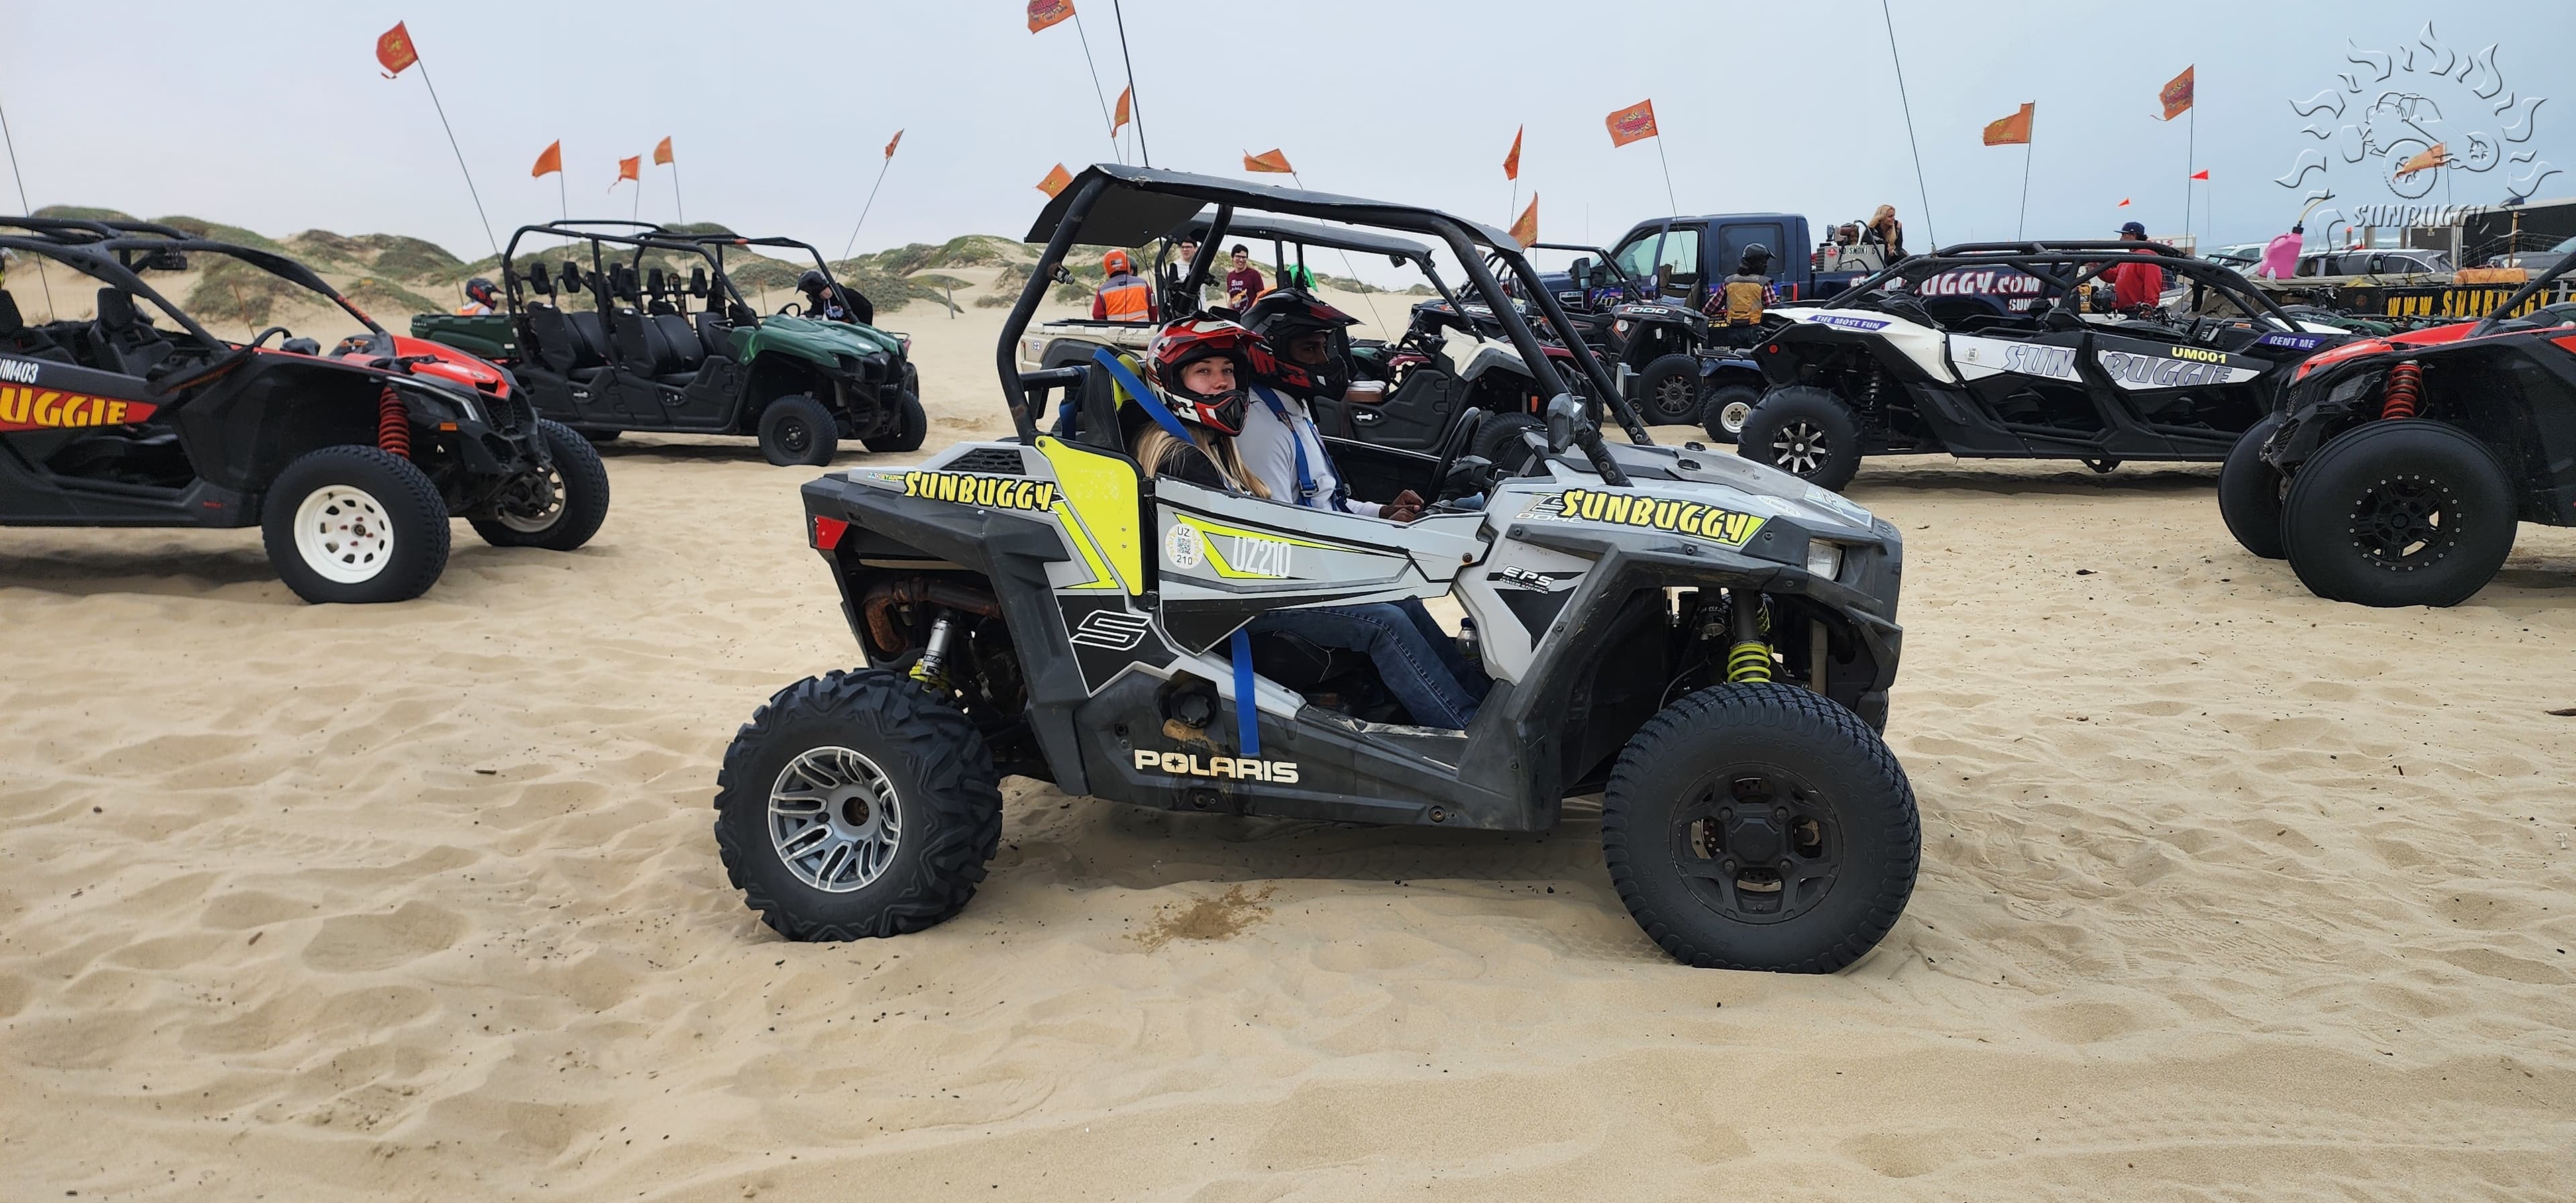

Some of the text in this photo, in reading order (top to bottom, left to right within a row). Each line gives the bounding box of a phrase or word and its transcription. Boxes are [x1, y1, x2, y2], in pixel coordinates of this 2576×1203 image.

[1849, 246, 1876, 255] SMOKIG
[1626, 307, 1669, 315] 1000
[2387, 289, 2550, 318] WWW SUNBUGY
[1816, 315, 1880, 329] THE MOST FUN
[2269, 335, 2316, 349] RENT ME
[2001, 344, 2076, 378] SUN
[2171, 346, 2226, 364] UM001
[2101, 353, 2233, 387] BUGGIE
[0, 386, 127, 428] UGGIE
[904, 470, 1055, 511] SUNBUGGY
[1562, 489, 1750, 543] SUNBUGGY
[1177, 526, 1190, 537] UZ
[1176, 554, 1193, 566] 210
[1232, 535, 1291, 578] UZ210
[1502, 566, 1554, 587] EPS
[1134, 749, 1299, 784] POLARIS
